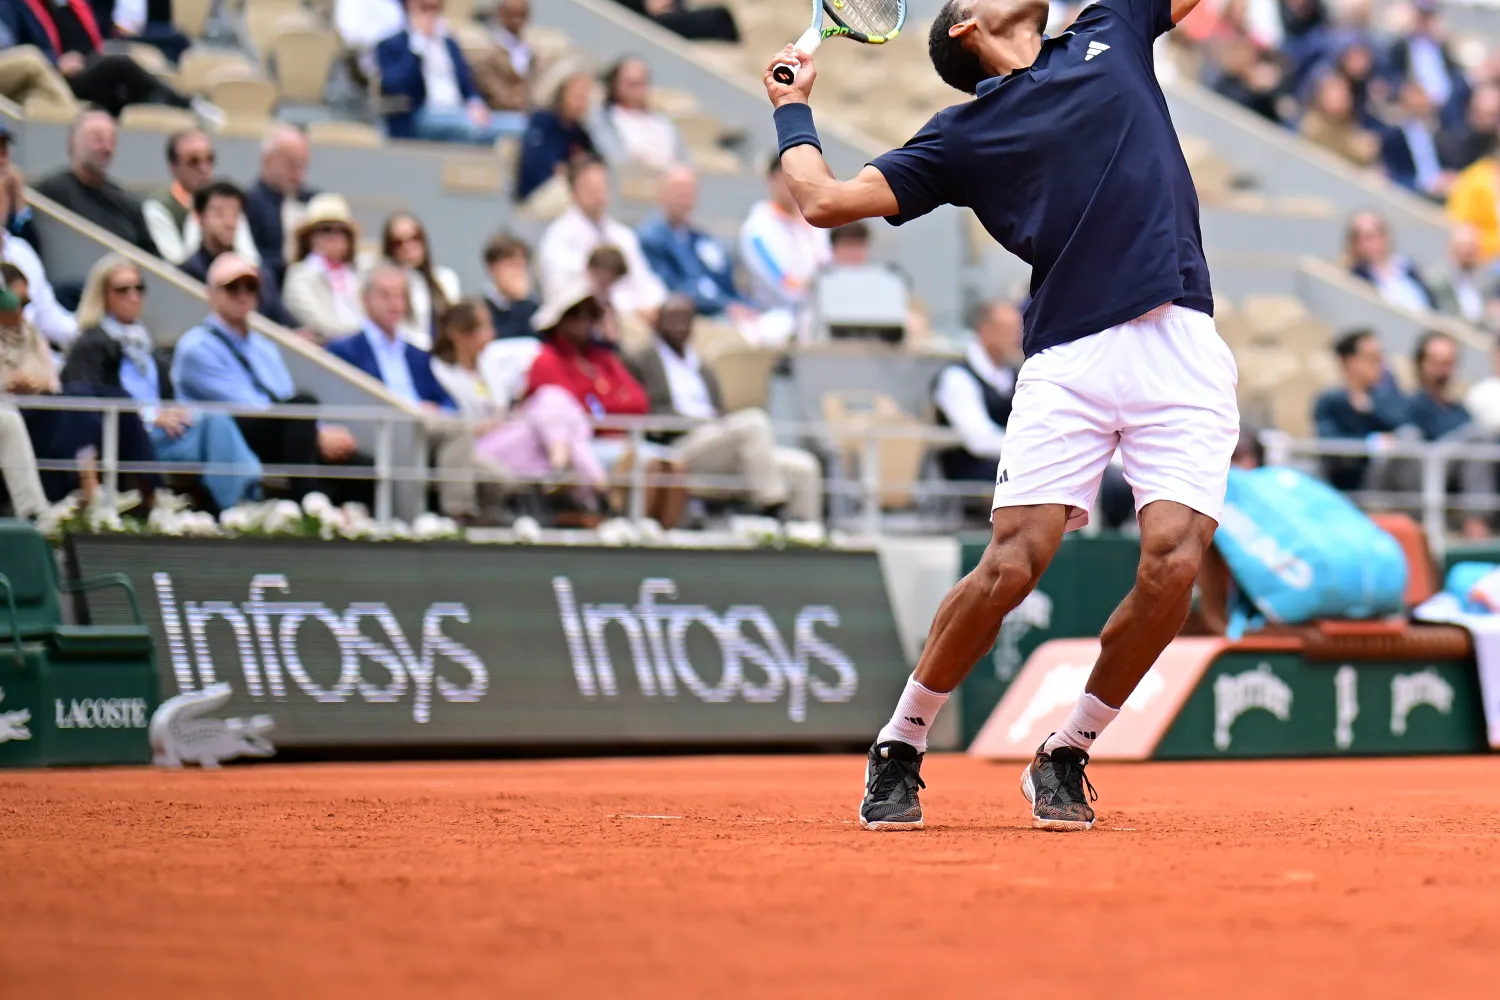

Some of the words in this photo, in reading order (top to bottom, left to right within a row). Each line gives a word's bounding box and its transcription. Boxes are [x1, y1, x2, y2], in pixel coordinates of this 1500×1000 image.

[55, 698, 148, 729] LACOSTE
[152, 571, 489, 724] Infosys
[552, 576, 859, 723] Infosys
